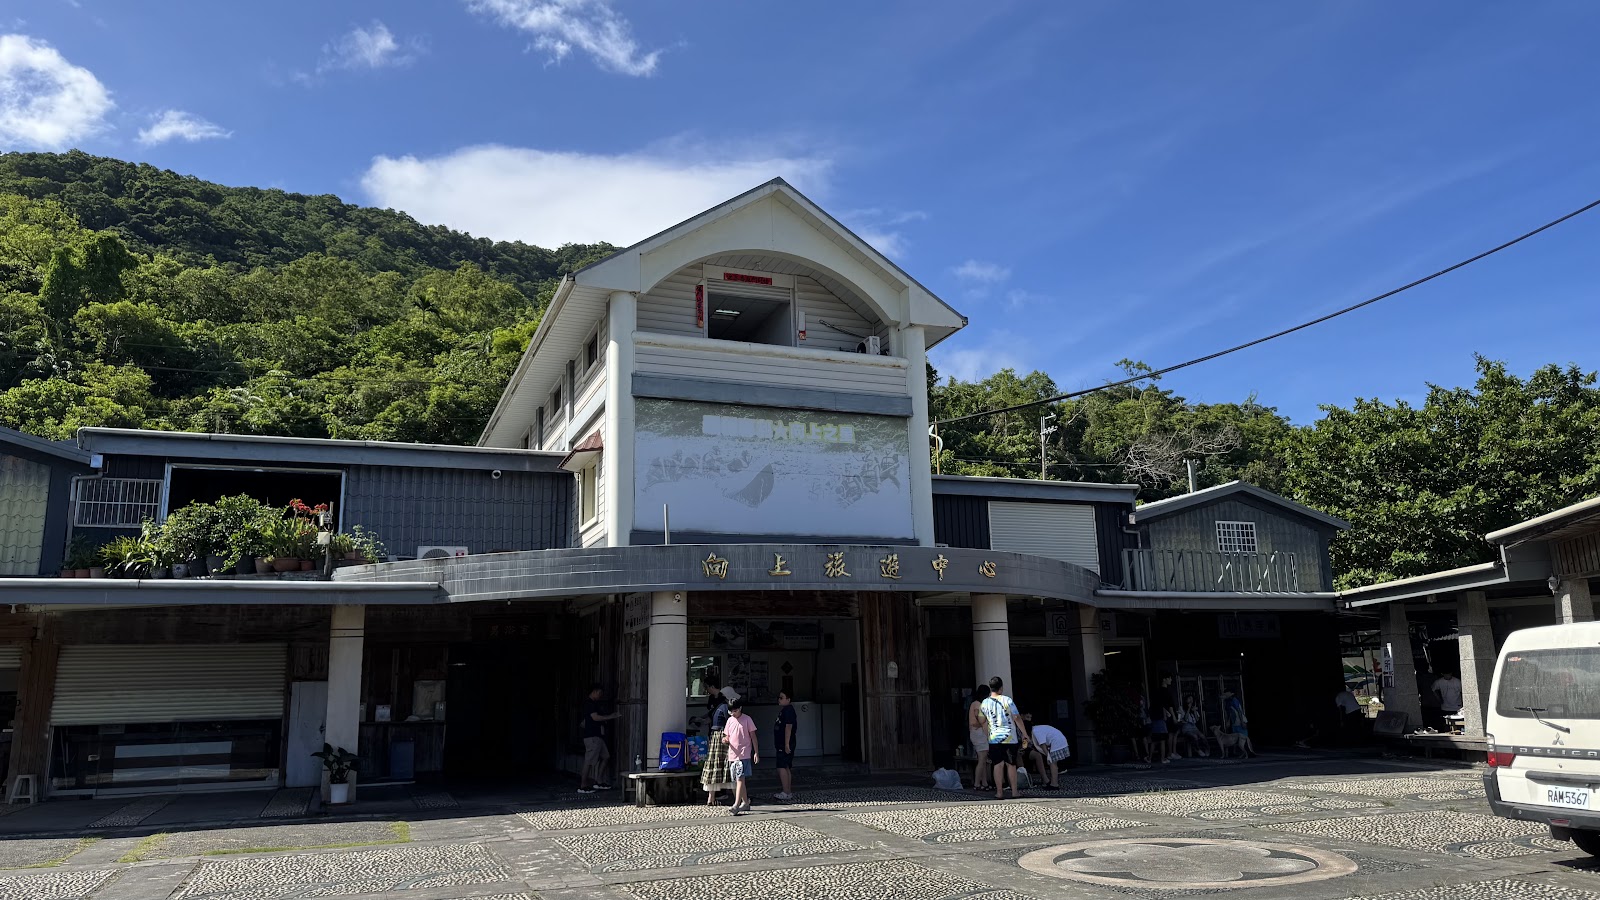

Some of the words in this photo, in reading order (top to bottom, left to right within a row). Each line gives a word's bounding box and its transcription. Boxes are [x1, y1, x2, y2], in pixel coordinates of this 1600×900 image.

[701, 552, 996, 581] 向上旅遊中心
[1519, 748, 1598, 757] DELICA
